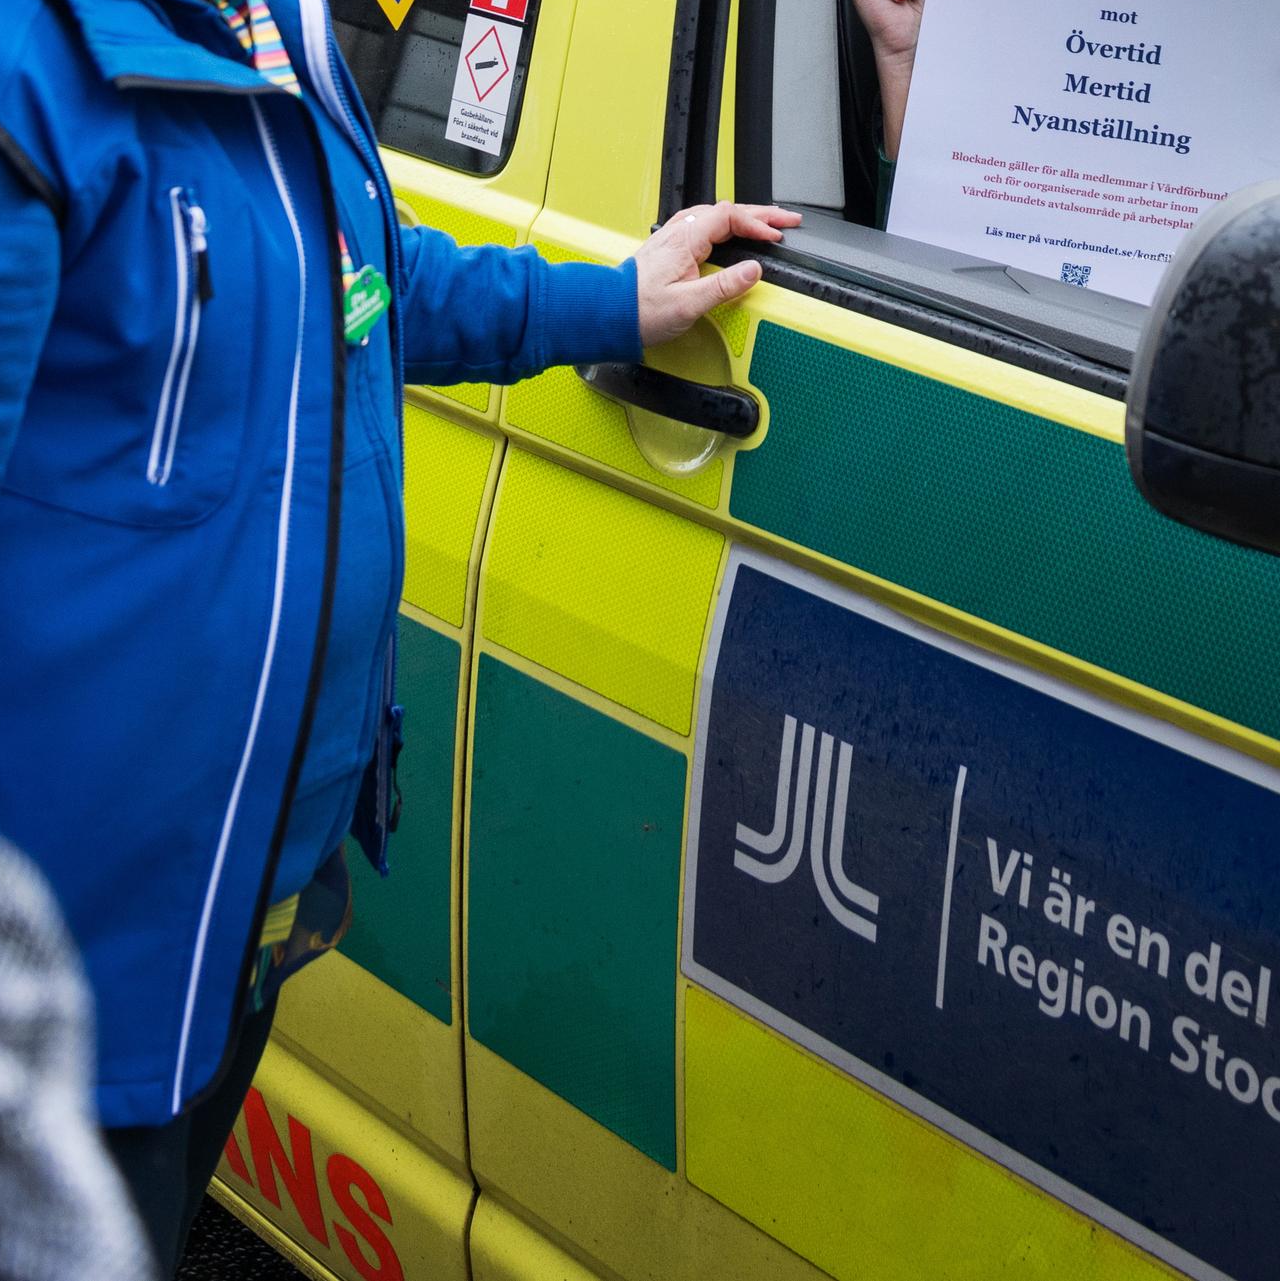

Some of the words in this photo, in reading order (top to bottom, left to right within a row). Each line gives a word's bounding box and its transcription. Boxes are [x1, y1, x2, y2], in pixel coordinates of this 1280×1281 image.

[1100, 9, 1139, 25] mot
[1065, 29, 1162, 65] Övertid
[1062, 73, 1151, 104] Mertid
[1011, 105, 1192, 155] Nyanställning
[951, 151, 1006, 168] Blockaden
[1008, 160, 1040, 172] gäller
[1042, 165, 1058, 176] för
[1060, 169, 1079, 179] alla
[1082, 173, 1148, 190] medlemmar
[961, 185, 1046, 207] Vårdförbundets
[1048, 199, 1121, 218] avtalsområde
[1122, 211, 1136, 222] på
[983, 174, 1002, 184] och
[1005, 176, 1021, 187] för
[1023, 181, 1100, 199] oorganiserade
[1101, 193, 1125, 203] som
[1127, 195, 1168, 210] arbetar
[1170, 201, 1199, 214] inom
[985, 226, 1003, 237] Läs
[1005, 230, 1026, 241] mer
[1028, 234, 1041, 244] på
[986, 837, 1035, 909] Vi
[1043, 867, 1096, 937] är
[1106, 913, 1170, 978] en
[1184, 942, 1271, 1028] del
[977, 913, 1152, 1052] Region
